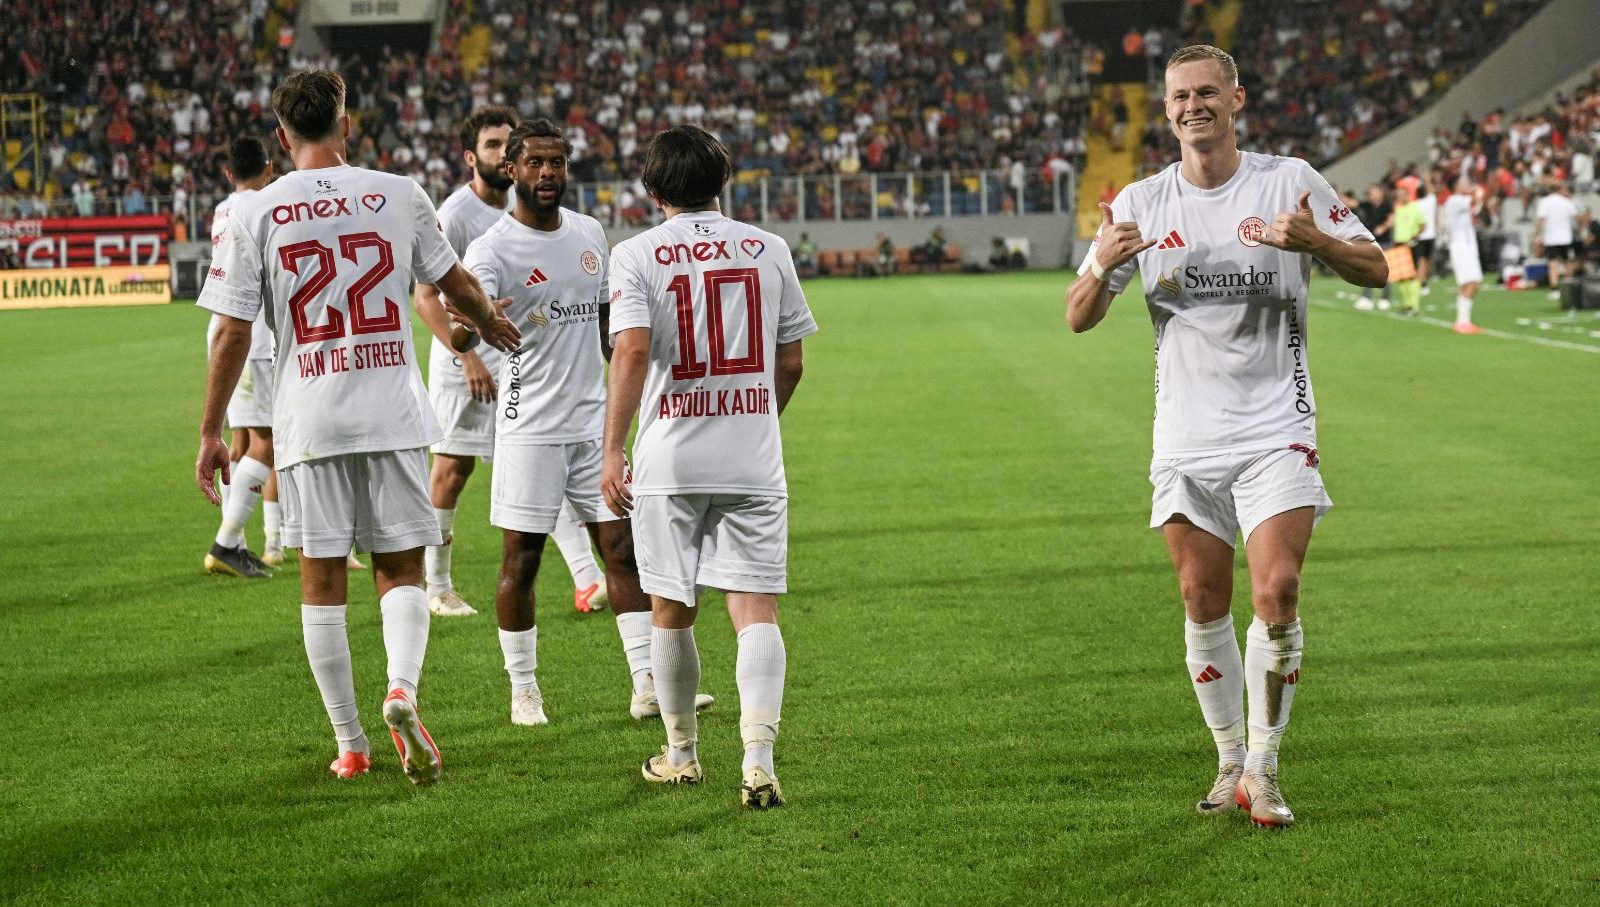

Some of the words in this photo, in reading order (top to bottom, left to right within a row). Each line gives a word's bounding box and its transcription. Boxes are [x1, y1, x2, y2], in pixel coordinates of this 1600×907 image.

[271, 197, 352, 225] anex
[654, 240, 731, 266] anex
[278, 231, 401, 345] 22
[1184, 265, 1278, 289] Swandor
[1194, 290, 1224, 298] HOTELS
[1235, 288, 1270, 296] RESORTS
[550, 296, 599, 320] Swand
[666, 267, 765, 381] 10
[297, 350, 325, 379] VAN
[331, 346, 349, 373] DE
[354, 340, 406, 370] STREEK
[658, 382, 770, 420] ABDÜLKADİR
